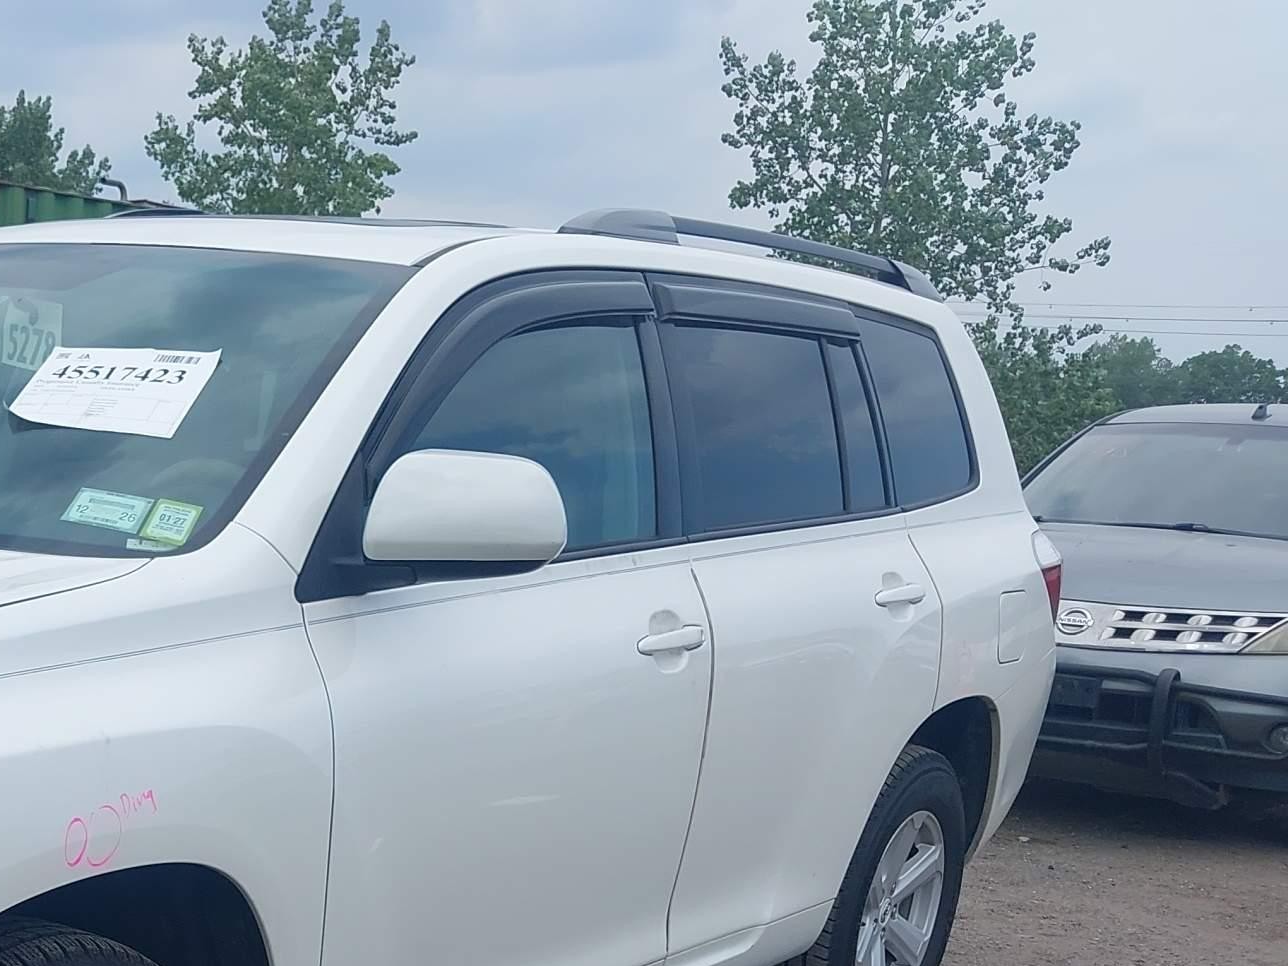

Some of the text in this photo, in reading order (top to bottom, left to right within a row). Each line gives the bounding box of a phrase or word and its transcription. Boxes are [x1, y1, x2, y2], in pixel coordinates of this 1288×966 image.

[52, 365, 186, 384] 45517423
[76, 504, 89, 513] 12
[119, 512, 136, 522] 26
[1056, 616, 1094, 626] NISSAN
